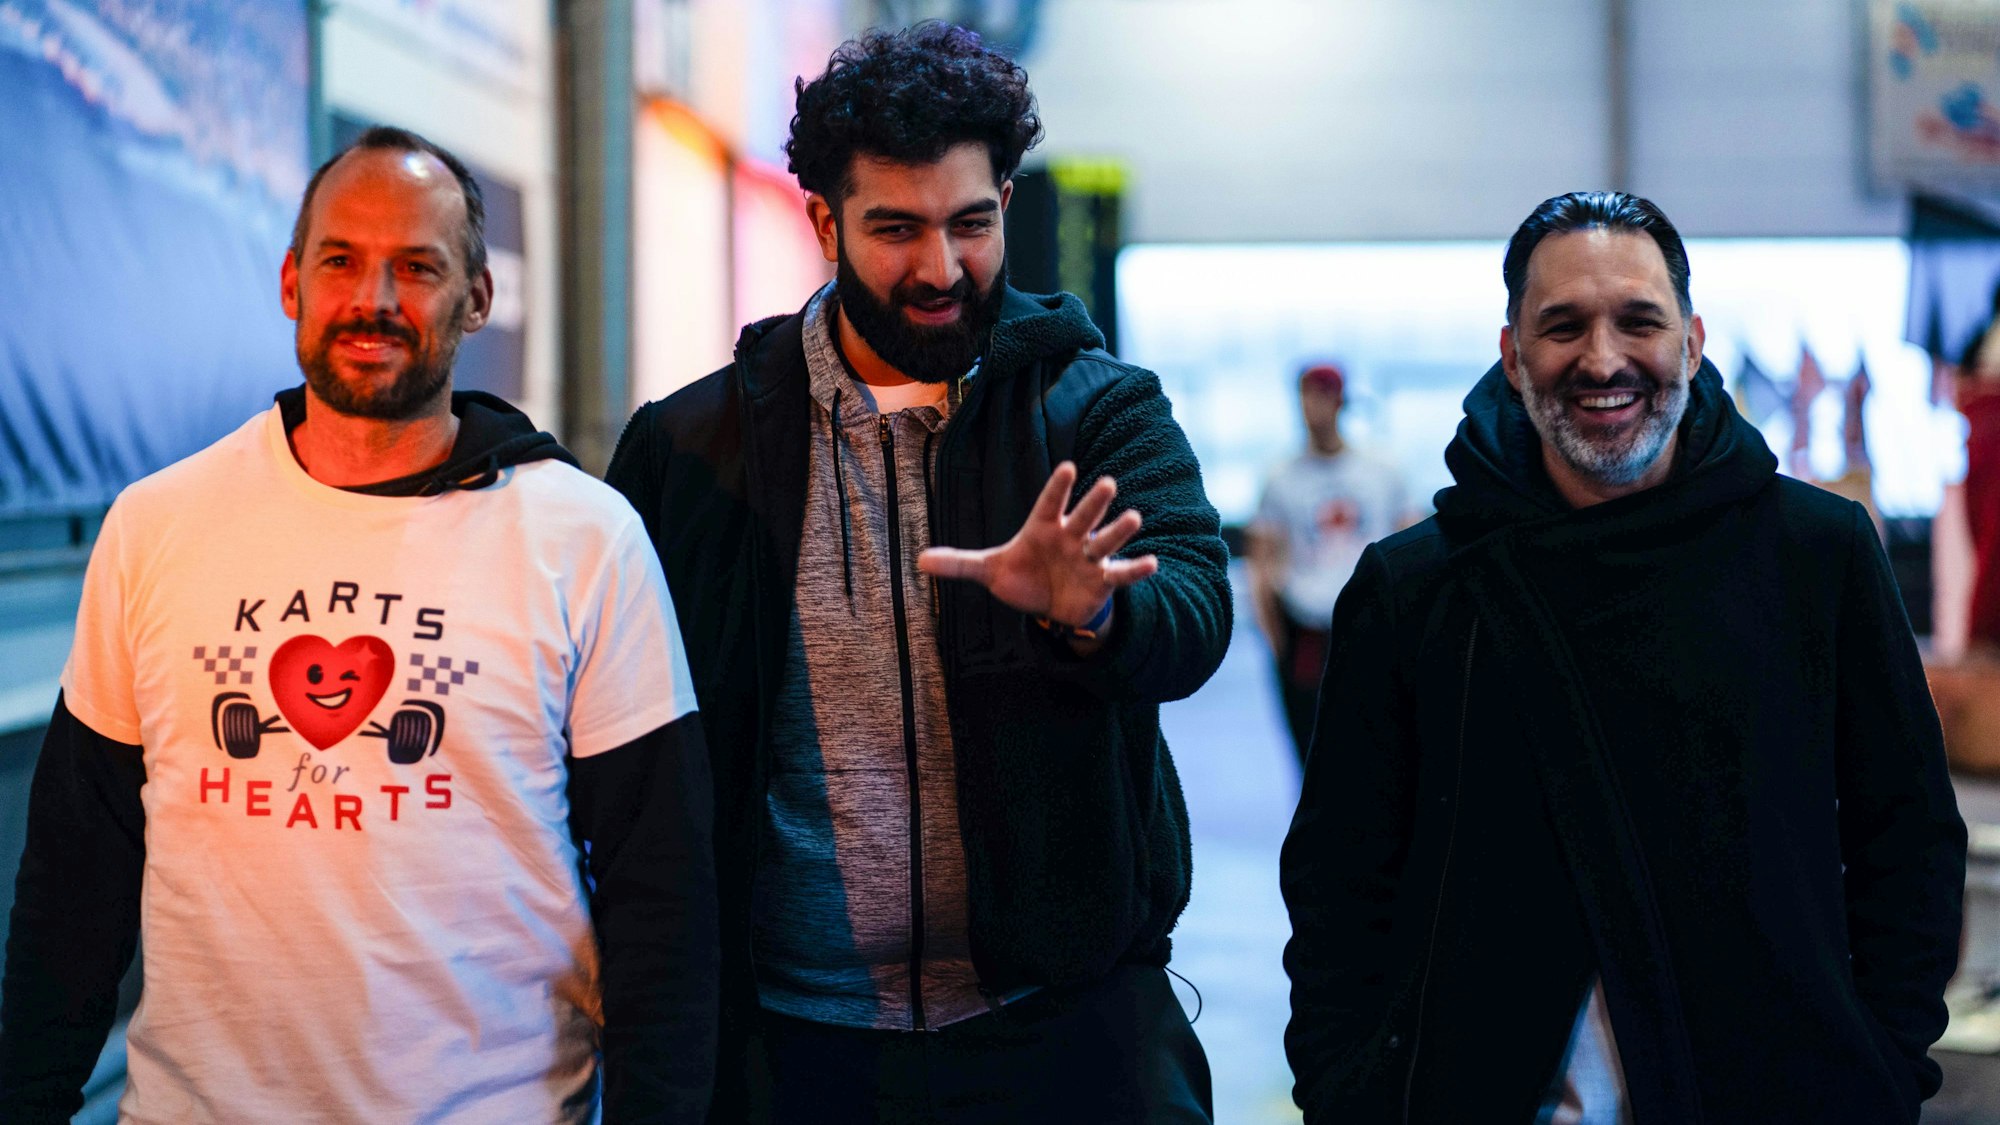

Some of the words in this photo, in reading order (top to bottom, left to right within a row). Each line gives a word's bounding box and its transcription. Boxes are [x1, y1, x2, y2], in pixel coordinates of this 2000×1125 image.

[234, 581, 445, 641] KARTS
[200, 767, 453, 831] HEARTS
[287, 752, 350, 792] for
